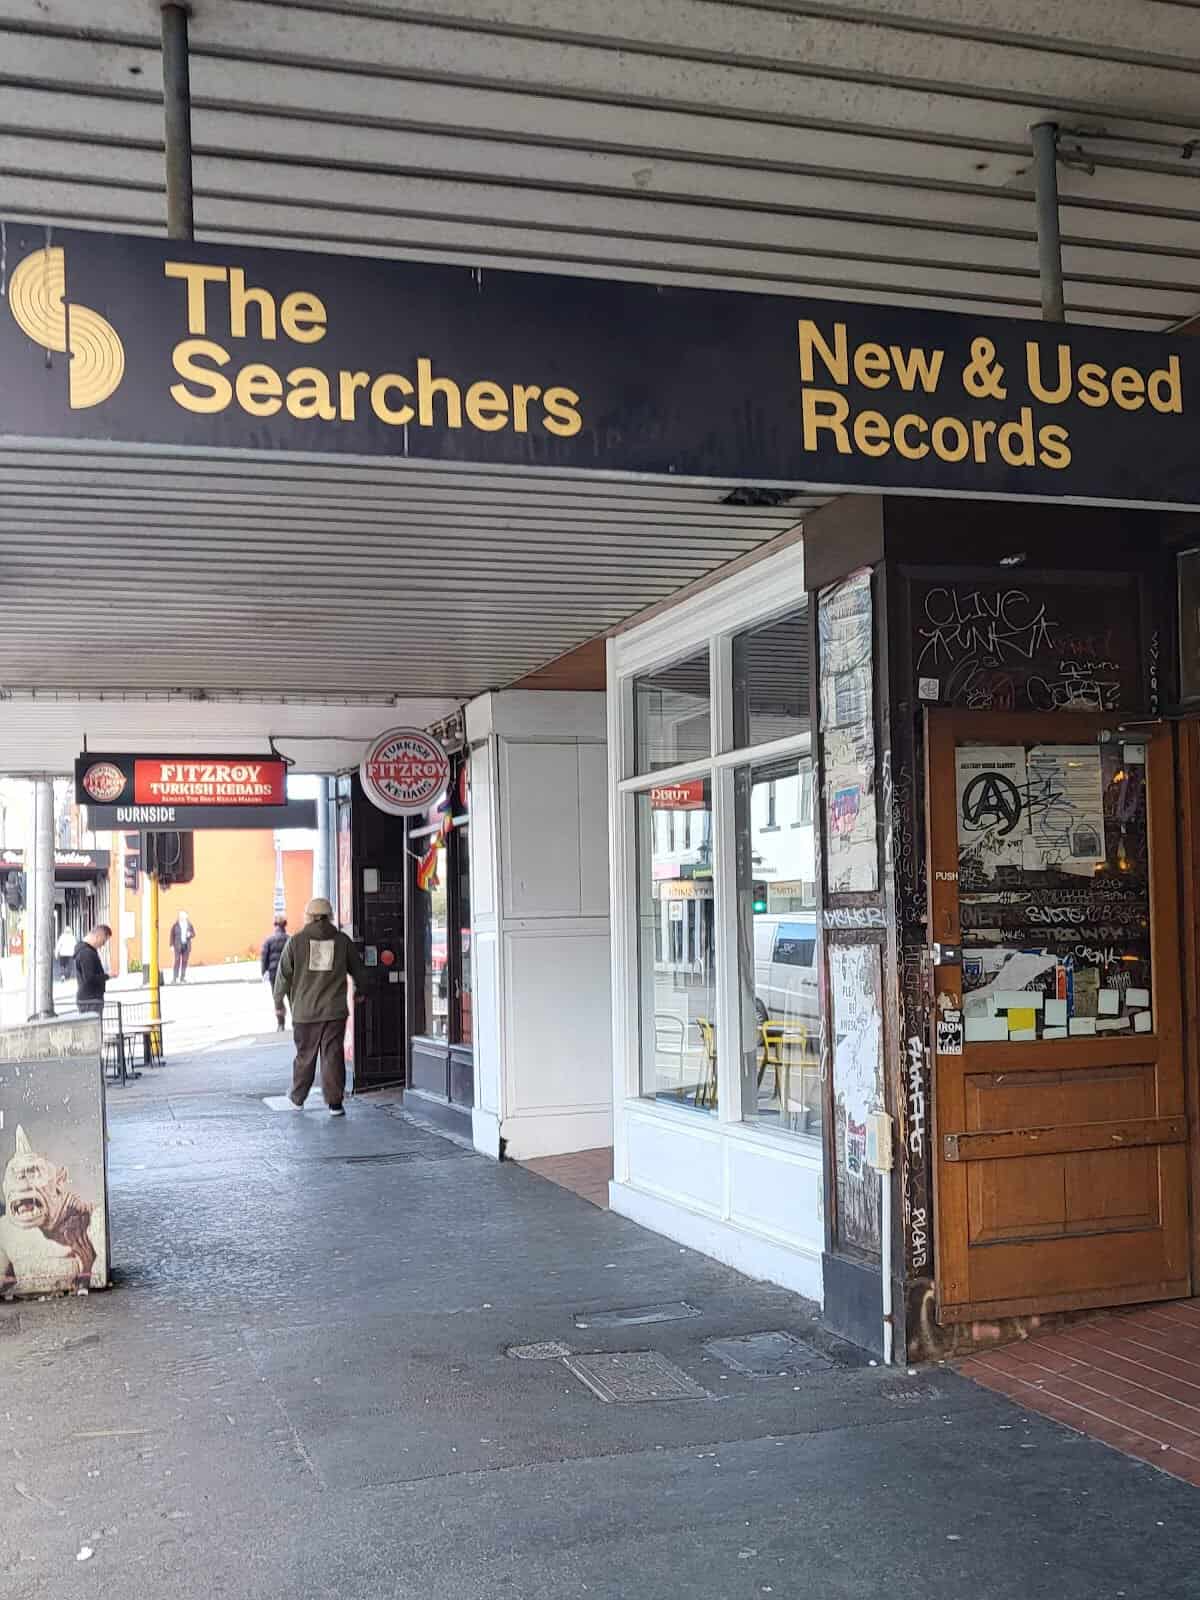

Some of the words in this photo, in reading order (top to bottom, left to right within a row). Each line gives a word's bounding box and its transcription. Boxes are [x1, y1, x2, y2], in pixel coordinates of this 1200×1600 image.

[165, 261, 327, 343] The
[798, 319, 944, 392] New
[962, 336, 1007, 400] &
[1026, 341, 1183, 414] Used
[169, 340, 583, 437] Searchers
[801, 388, 1072, 470] Records
[383, 741, 431, 759] TURKISH
[160, 764, 262, 783] FITZROY
[367, 761, 448, 777] FITZROY
[150, 782, 213, 795] TURKISH
[216, 783, 272, 796] KEBABS
[385, 780, 432, 800] KEBABS
[117, 807, 175, 823] BURNSIDE
[935, 872, 958, 881] PUSH
